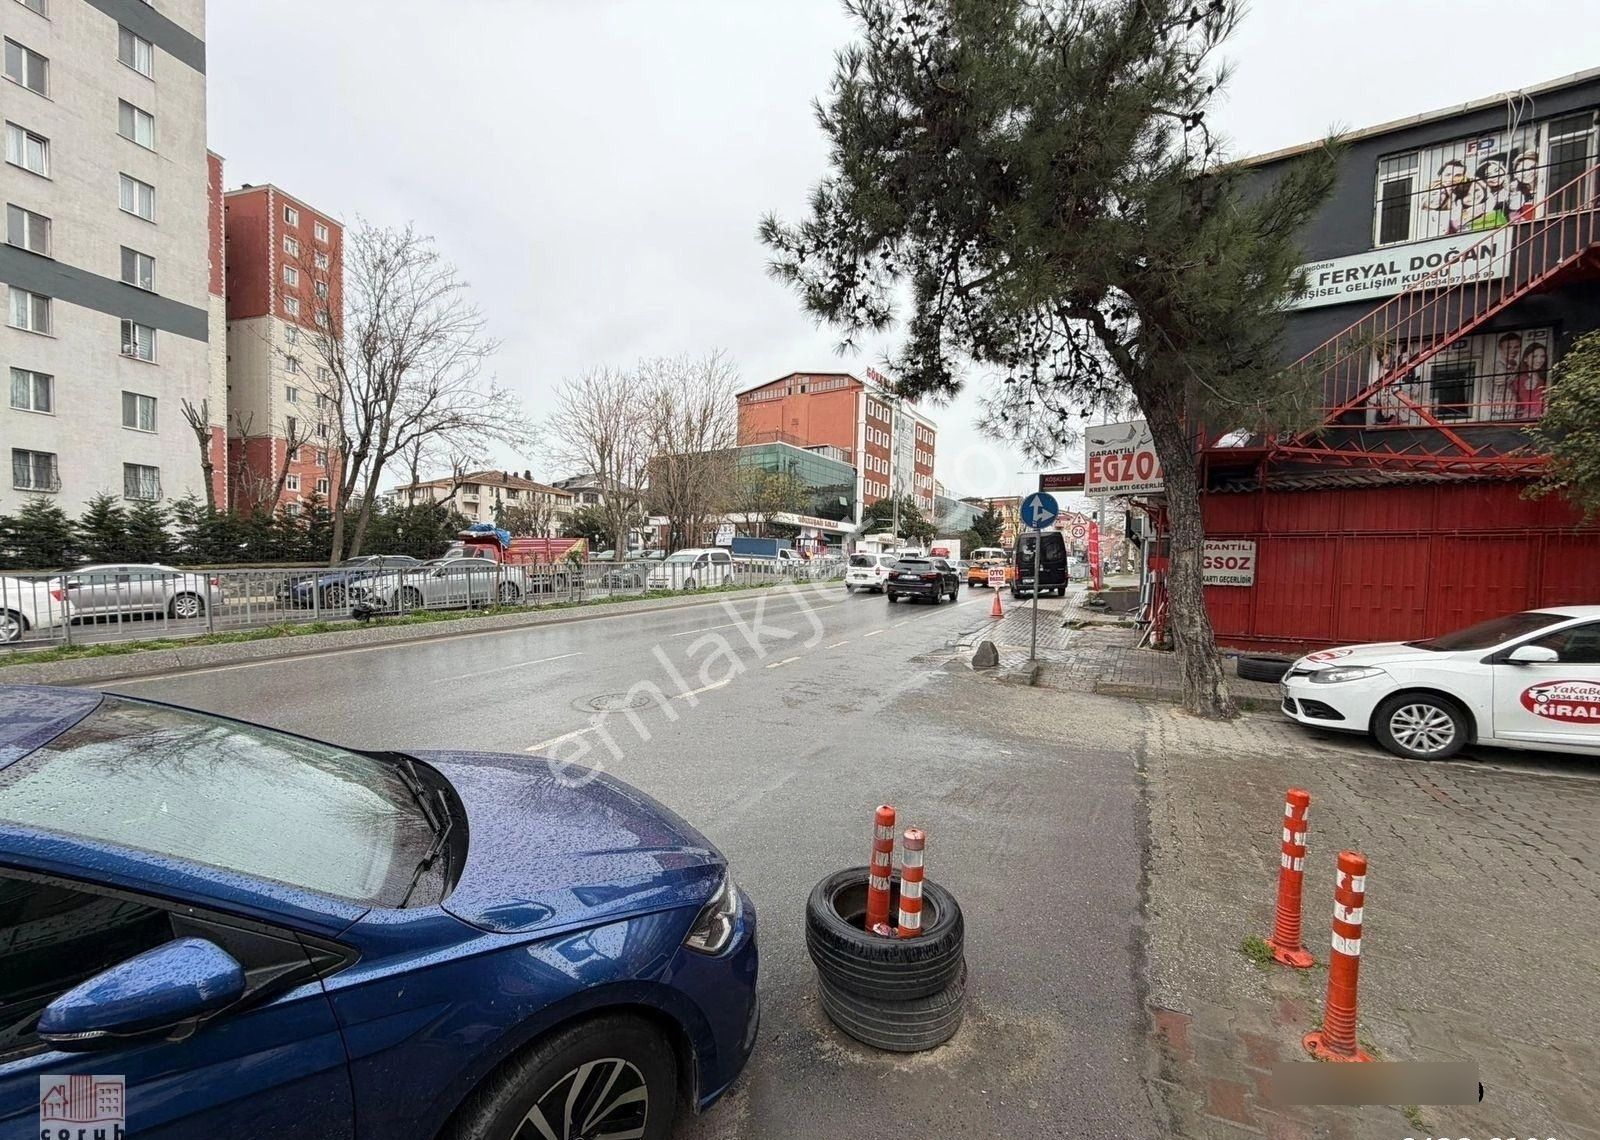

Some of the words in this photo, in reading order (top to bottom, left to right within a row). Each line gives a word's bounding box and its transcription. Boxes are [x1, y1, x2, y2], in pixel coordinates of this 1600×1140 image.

[1319, 261, 1401, 286] FERYAL
[1410, 243, 1497, 271] DOĞAN
[1346, 277, 1397, 293] GELİŞİM
[1089, 446, 1135, 457] GARANTİLİ
[1131, 482, 1165, 490] GEÇERLİD
[1074, 528, 1083, 536] 20
[1205, 543, 1252, 551] RANTİLİ
[1203, 556, 1250, 570] GSOZ
